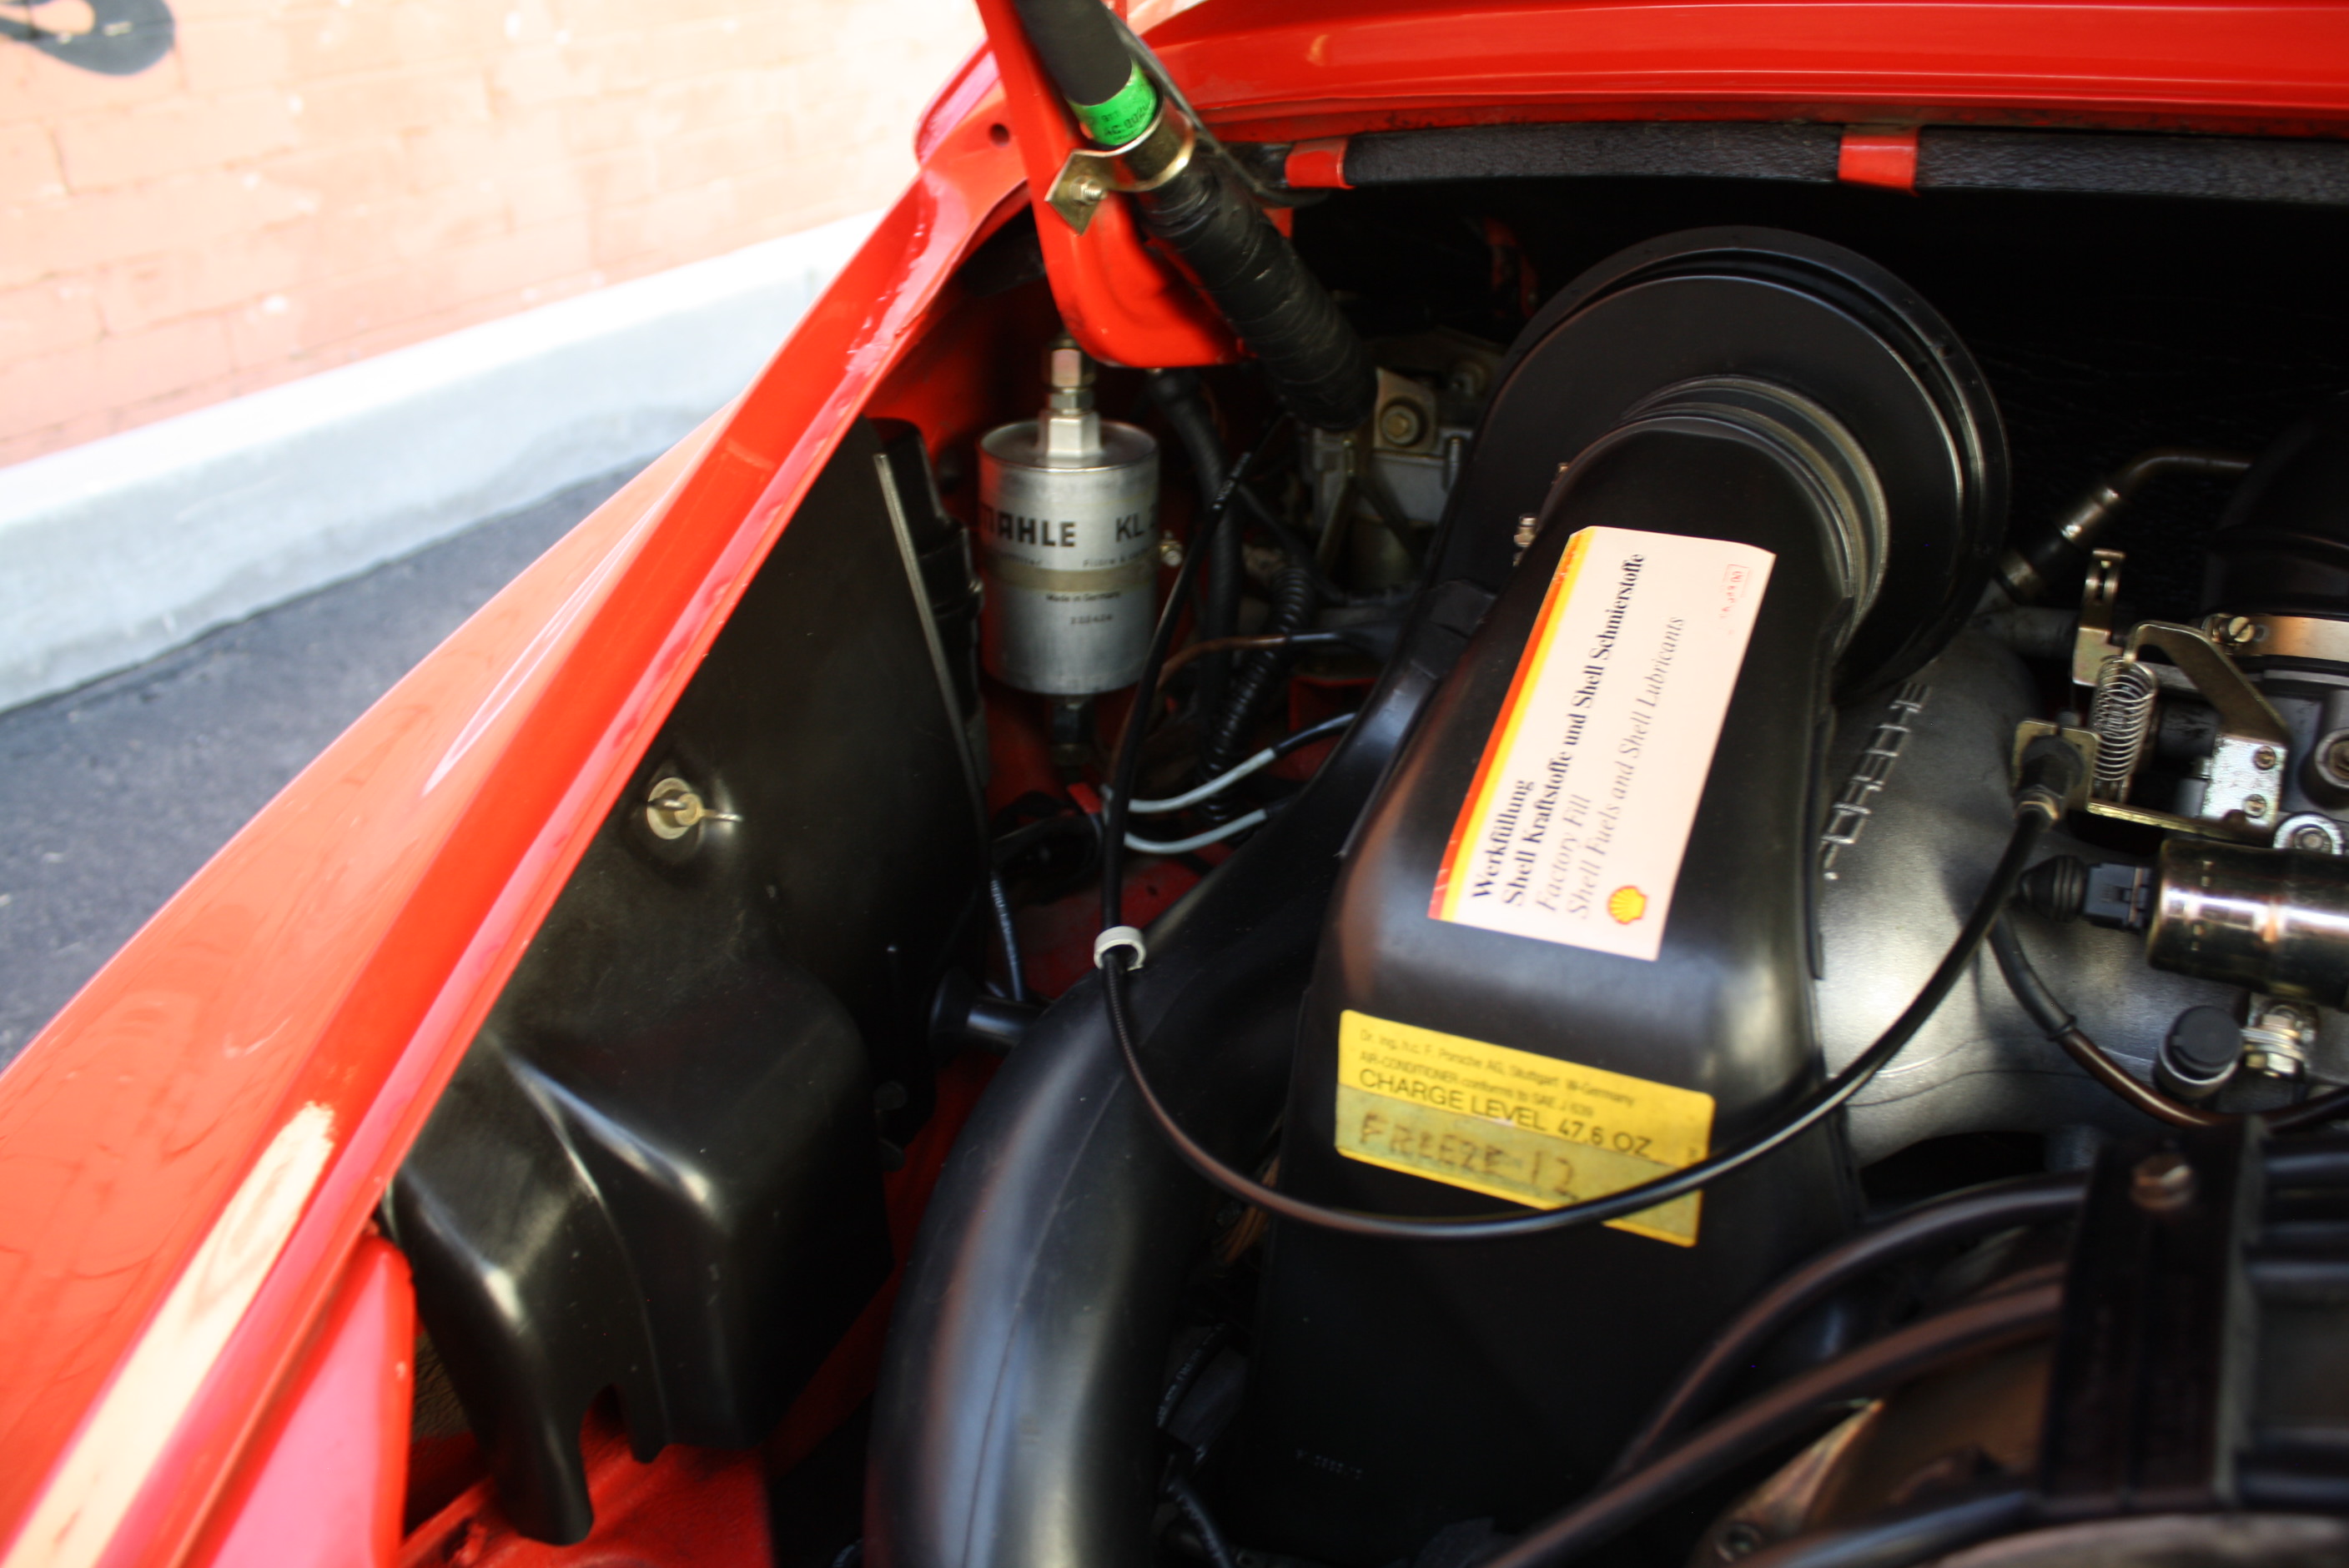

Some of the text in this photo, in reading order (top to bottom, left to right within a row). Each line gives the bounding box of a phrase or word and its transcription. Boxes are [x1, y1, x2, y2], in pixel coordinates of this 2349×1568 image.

[1501, 553, 1644, 907] Shell Kraftstoffe und Shell Schmierstoffe
[1567, 616, 1685, 919] Shell Fuels and Shell Lubricants
[1536, 793, 1591, 911] Factory Fill
[1359, 1068, 1465, 1111] CHARGE
[1471, 1094, 1547, 1133] LEVEL
[1557, 1118, 1604, 1146] 47.6
[1613, 1131, 1653, 1158] OZ
[1517, 1091, 1528, 1103] to
